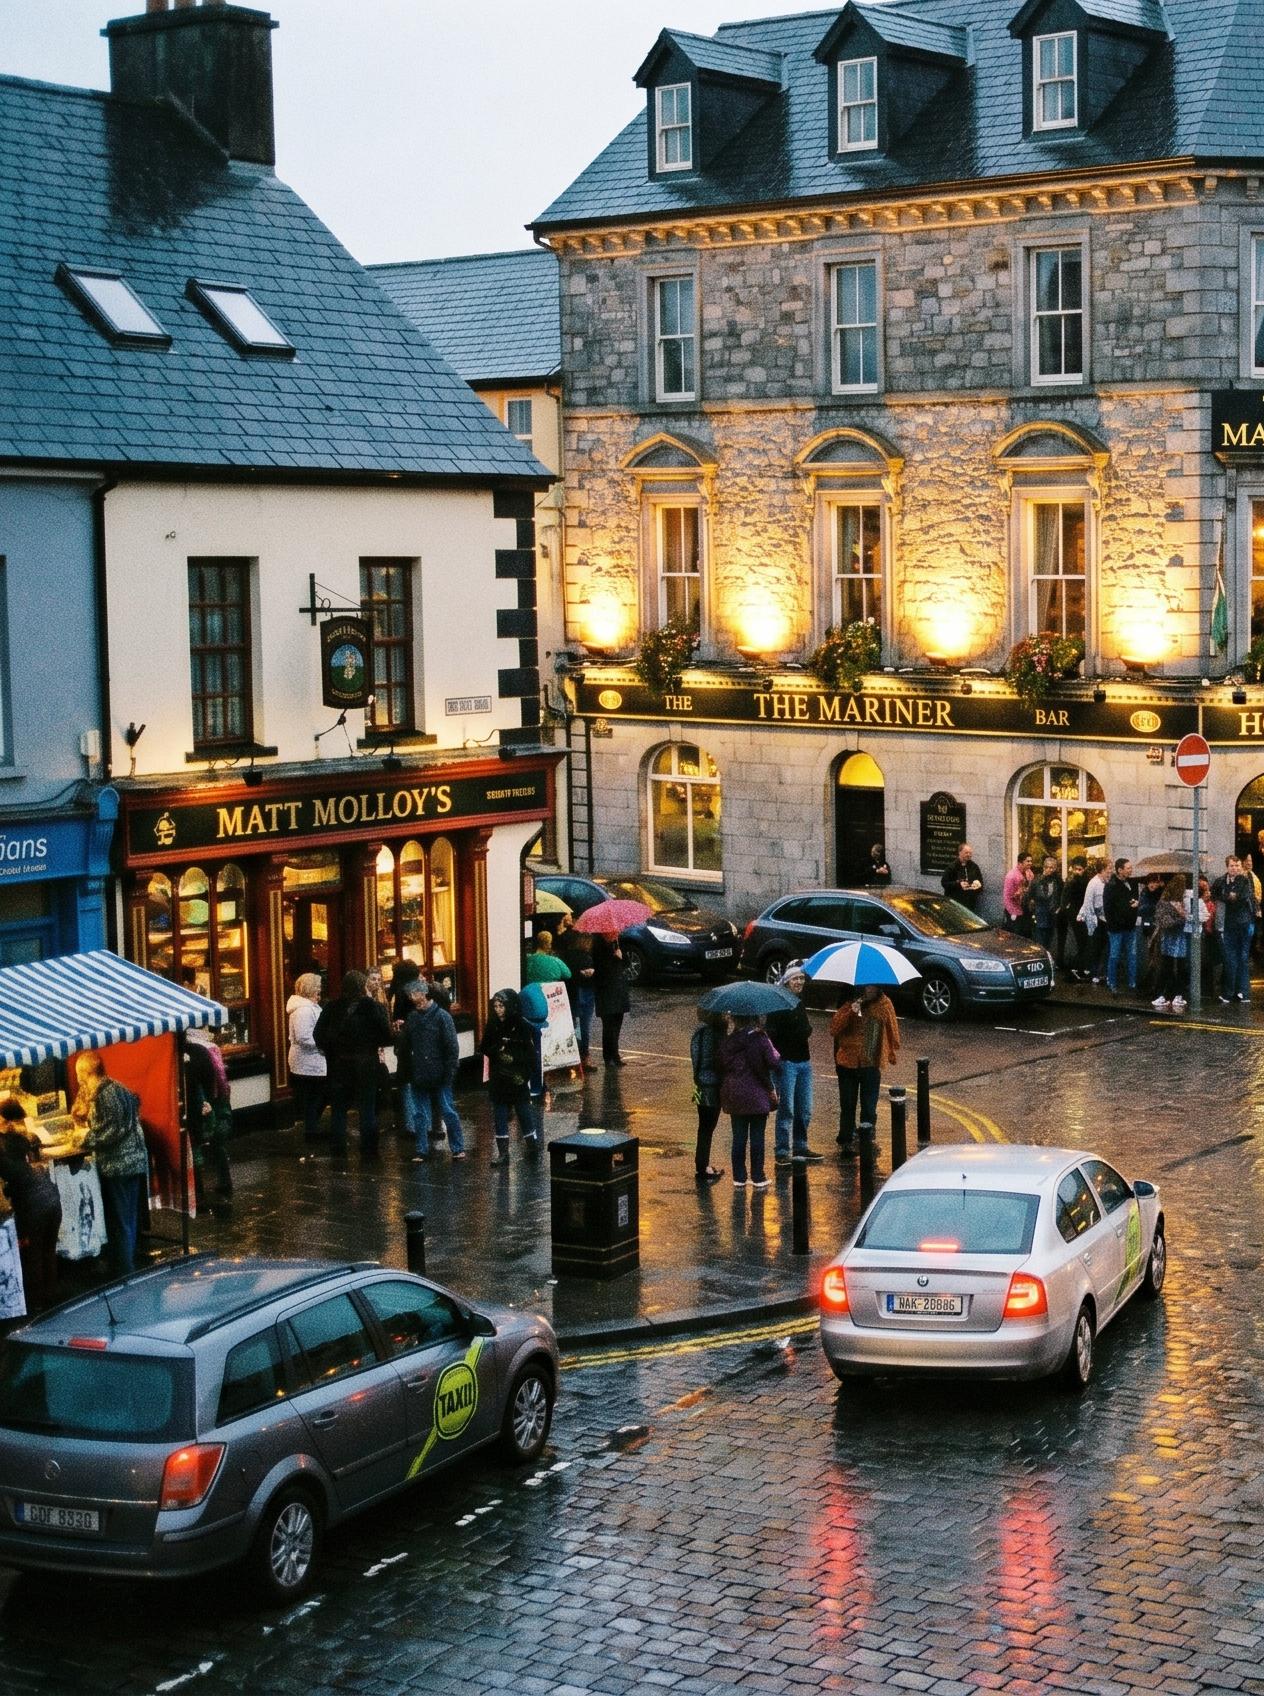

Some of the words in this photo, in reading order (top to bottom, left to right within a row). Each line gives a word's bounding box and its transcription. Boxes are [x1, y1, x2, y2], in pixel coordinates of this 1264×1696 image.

[664, 695, 693, 711] THE
[753, 693, 810, 720] THE
[816, 695, 956, 727] MARINER
[1035, 709, 1070, 726] BAR
[216, 801, 303, 838] MATT
[312, 785, 452, 827] MOLLOY'S
